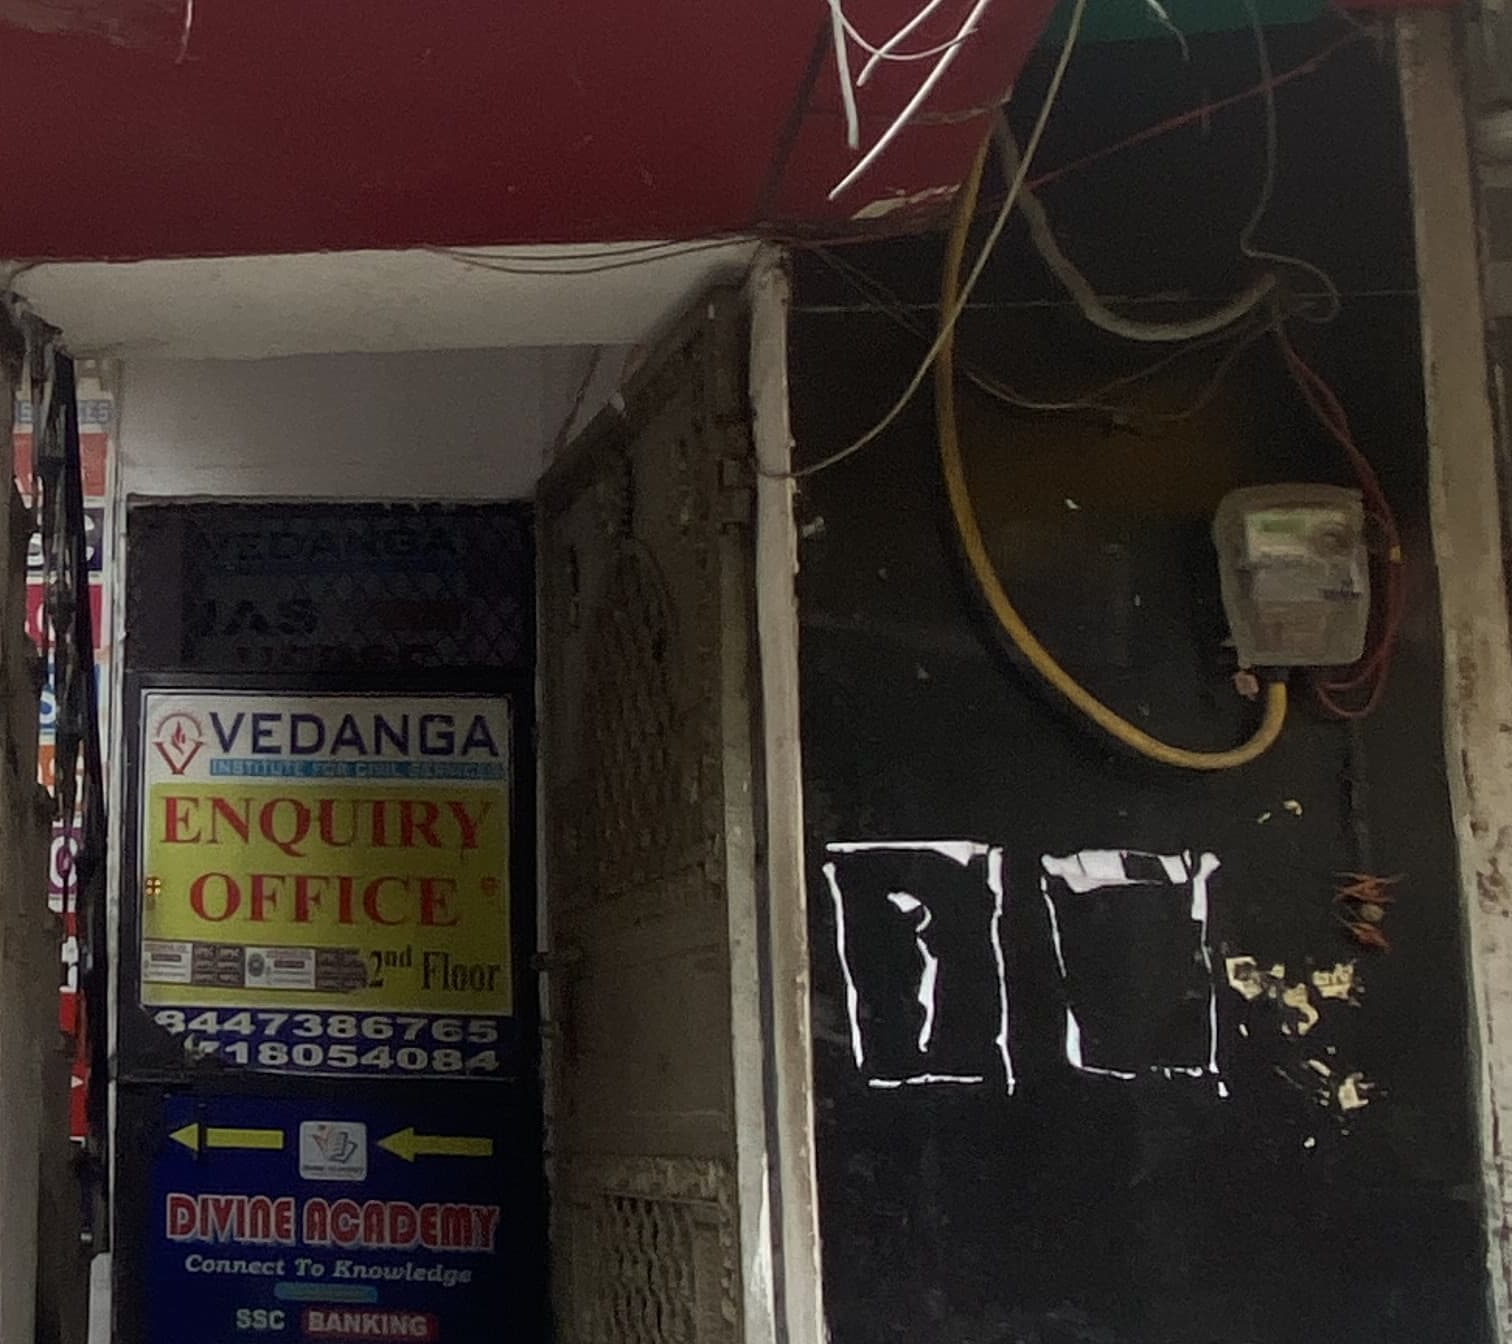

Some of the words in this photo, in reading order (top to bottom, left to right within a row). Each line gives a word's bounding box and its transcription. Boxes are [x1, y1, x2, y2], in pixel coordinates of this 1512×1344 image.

[208, 711, 501, 757] VEDANGA
[211, 759, 304, 775] INSTITUTE
[159, 795, 498, 857] ENQUIRY
[189, 871, 459, 928] OFFICE
[368, 945, 413, 988] 2nd
[422, 951, 502, 994] Floor
[154, 1009, 499, 1045] 8447386765
[166, 1192, 297, 1246] DIVINE
[301, 1197, 502, 1253] ACADEMY
[184, 1253, 285, 1278] Connect
[295, 1259, 324, 1278] To
[331, 1260, 473, 1287] Knowledge
[235, 1308, 286, 1331] SSC
[307, 1311, 429, 1338] BANKING
